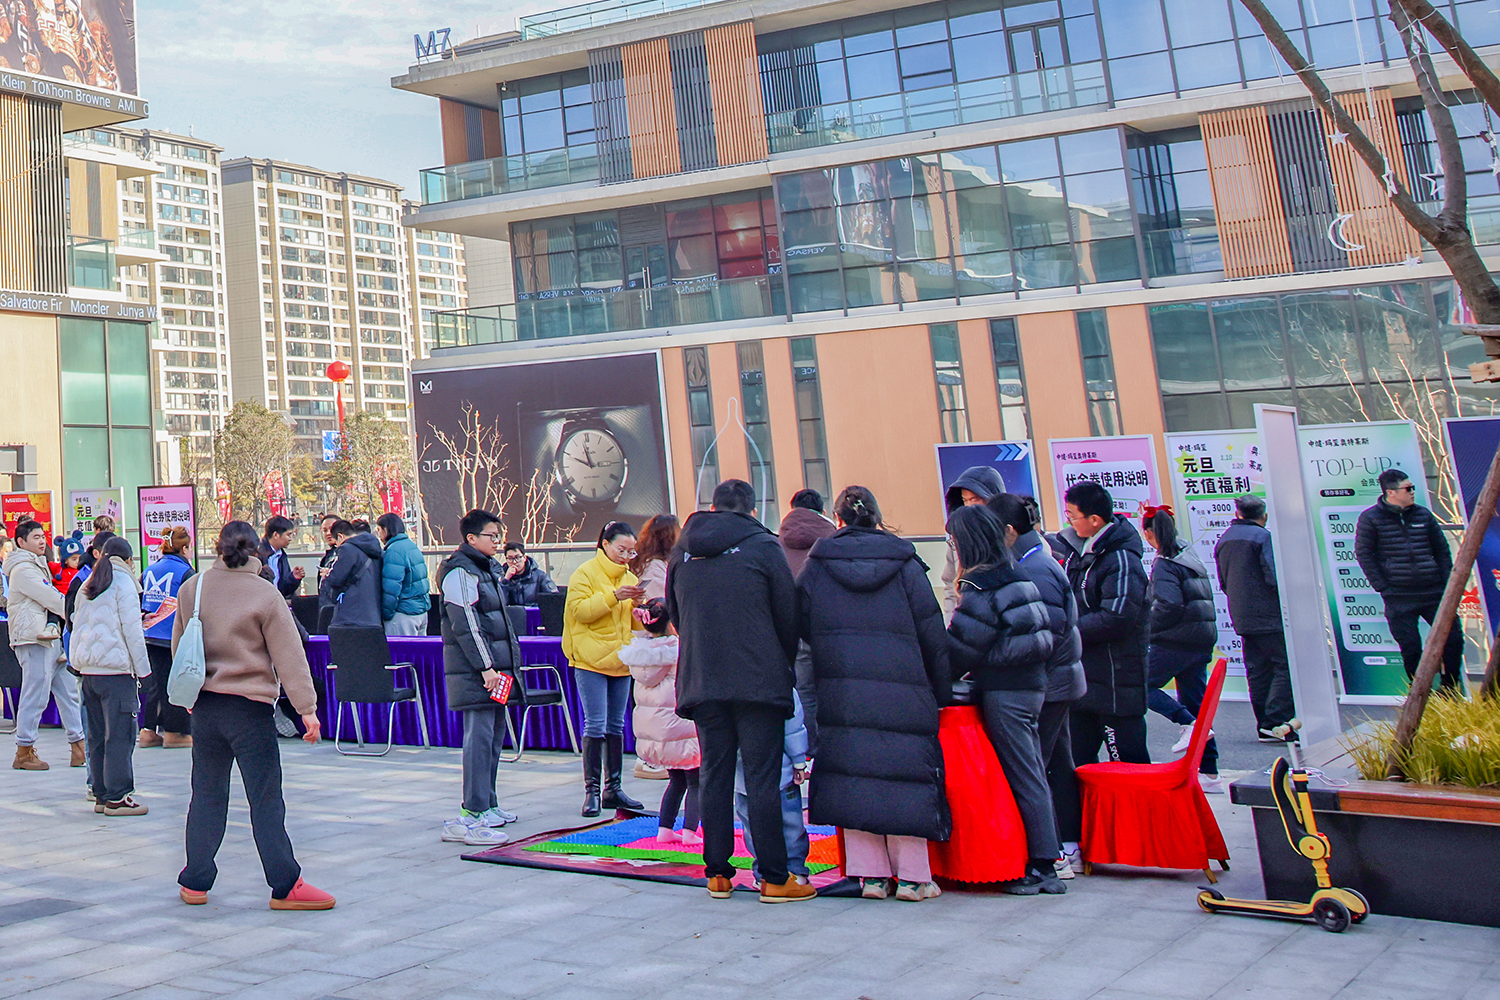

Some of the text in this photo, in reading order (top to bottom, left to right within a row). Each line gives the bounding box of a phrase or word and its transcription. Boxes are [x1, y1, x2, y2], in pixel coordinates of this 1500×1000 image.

[414, 27, 451, 58] M7
[1, 73, 27, 91] Klein
[75, 89, 111, 108] Browne
[117, 98, 136, 112] AMI
[0, 293, 48, 311] Salvatore
[70, 299, 110, 315] Moncler
[117, 303, 145, 319] Junya
[1183, 457, 1215, 473] 元旦
[1183, 475, 1251, 494] 充值福利
[77, 506, 92, 517] 元旦
[1212, 503, 1231, 512] 3000
[76, 521, 94, 531] 充值
[1330, 523, 1355, 533] 3000
[1346, 605, 1376, 616] 20000
[1351, 633, 1382, 644] 50000
